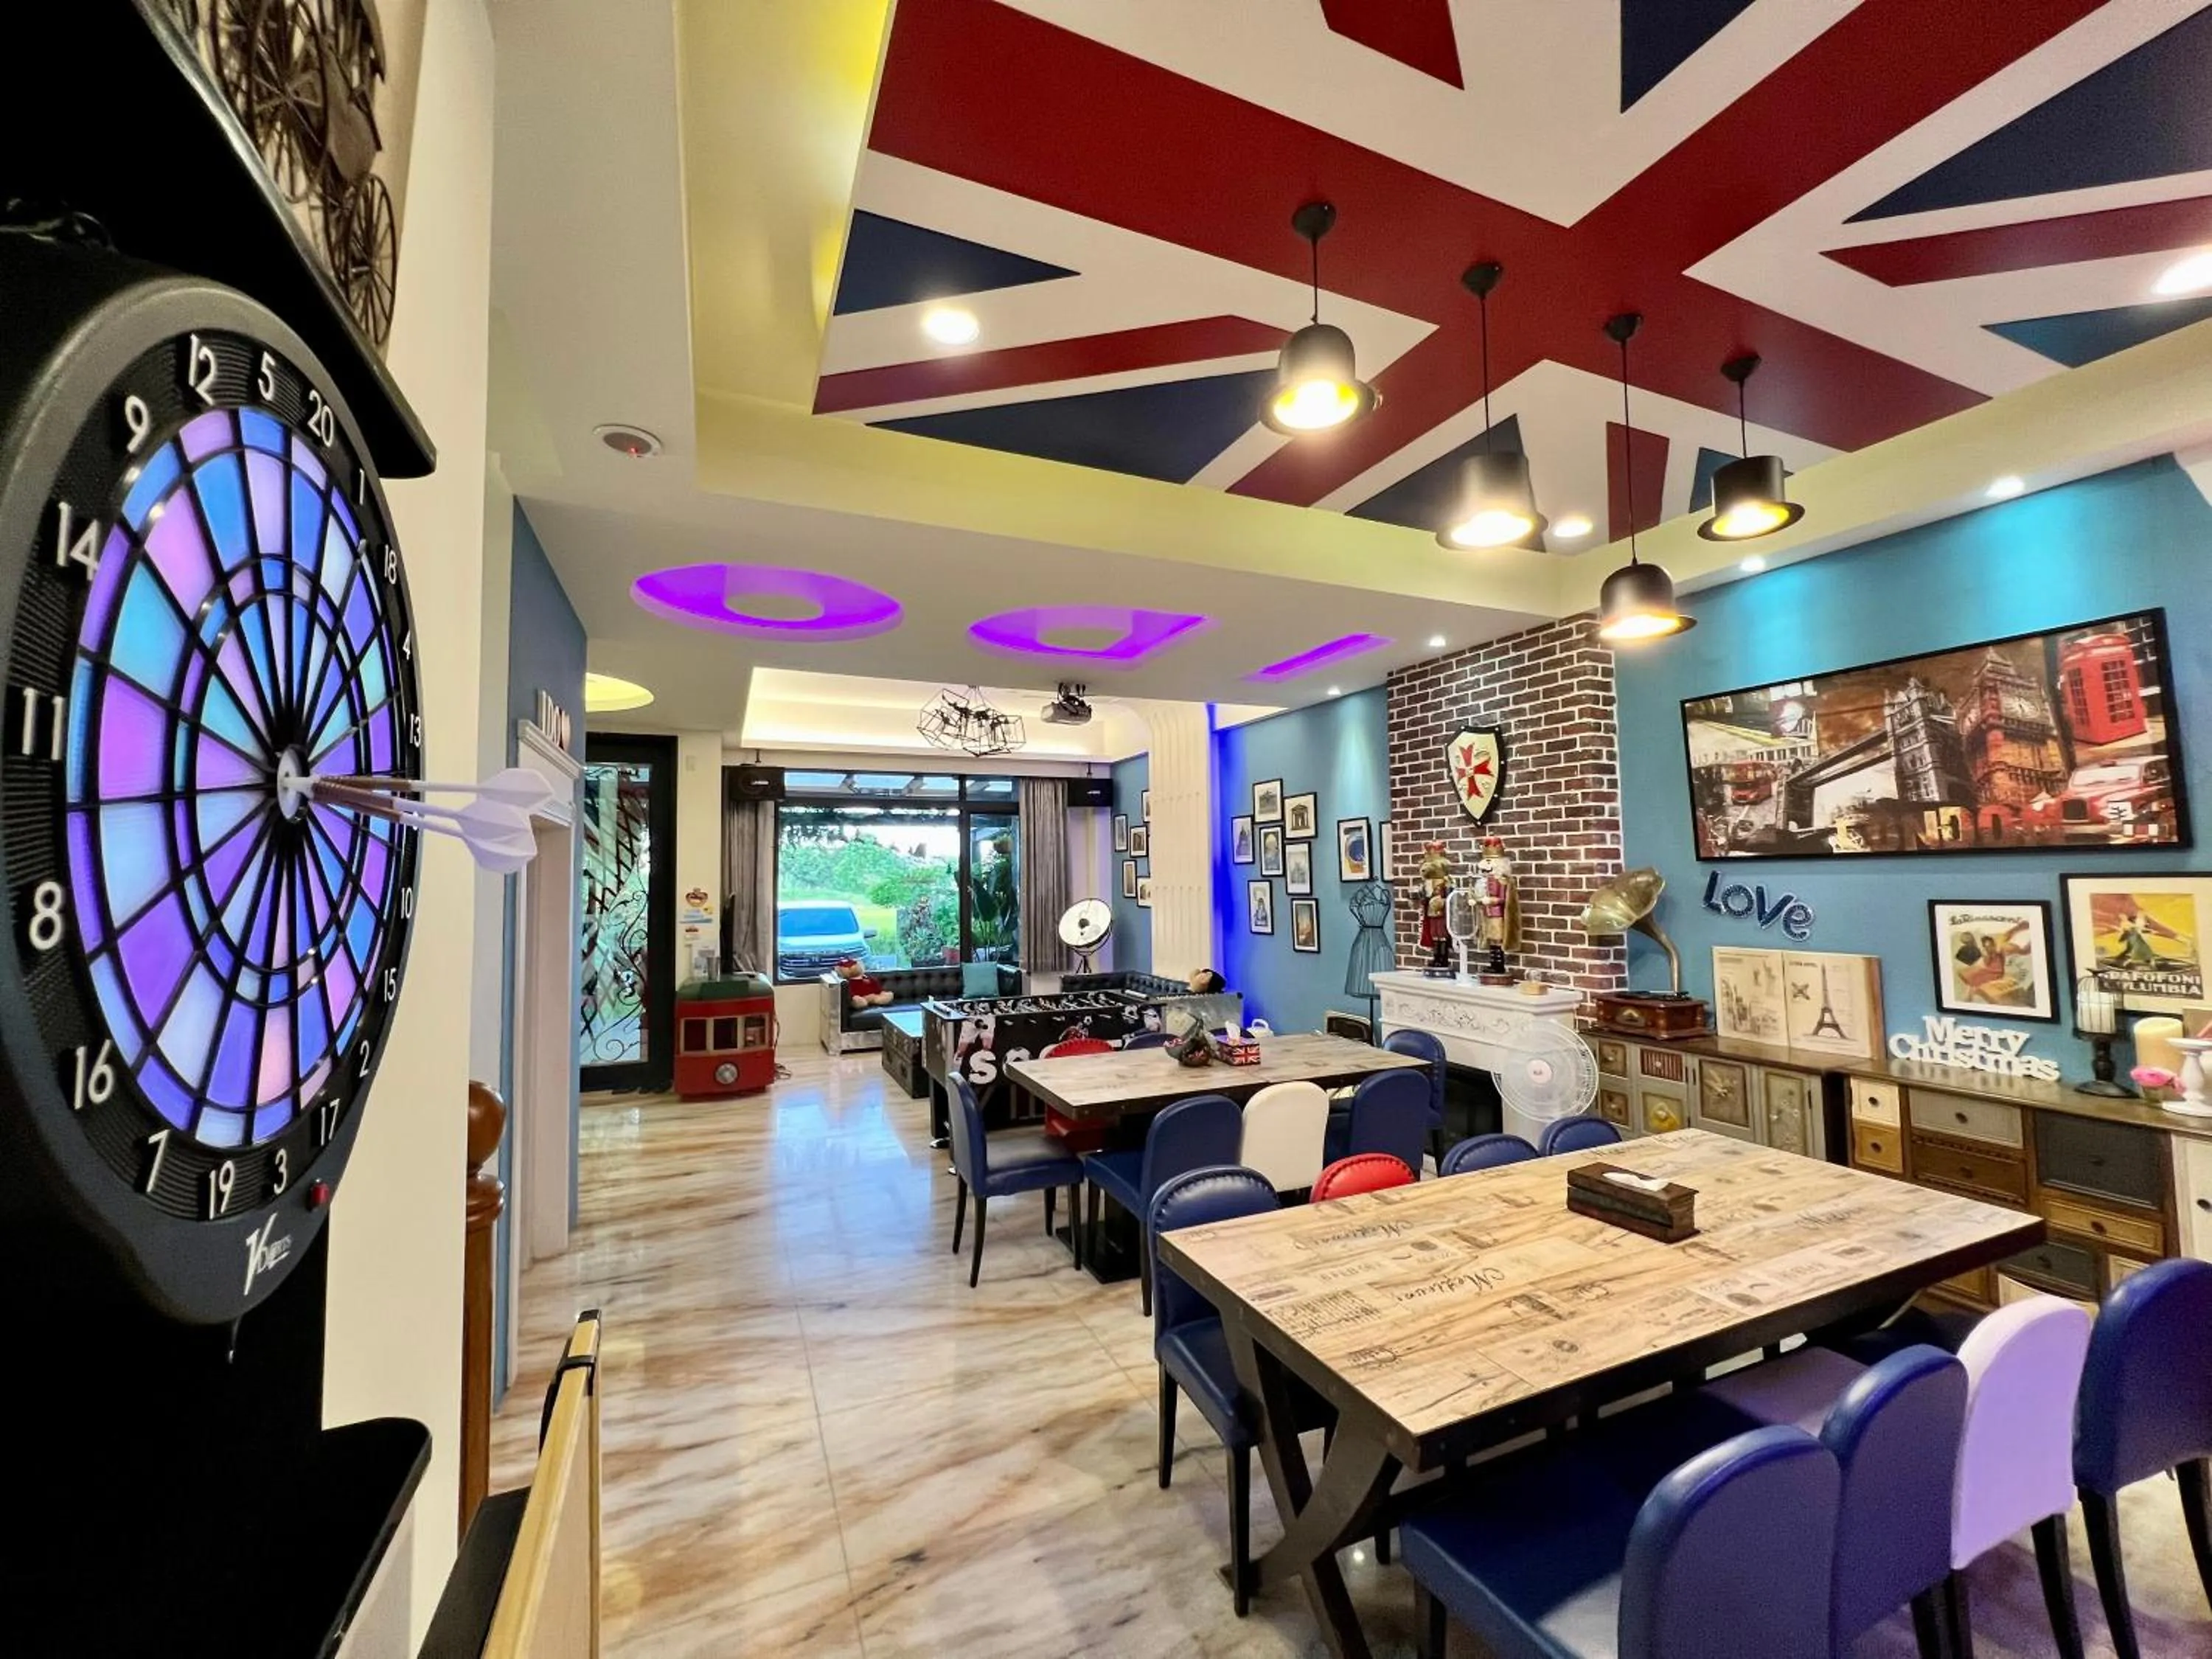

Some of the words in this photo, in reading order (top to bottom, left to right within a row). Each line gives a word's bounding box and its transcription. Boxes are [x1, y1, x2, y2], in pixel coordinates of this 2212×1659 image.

[189, 334, 218, 405] 12
[257, 352, 276, 400] 5
[125, 394, 150, 453] 9
[307, 389, 335, 447] 20
[359, 467, 365, 506] 1
[58, 501, 100, 581] 14
[384, 544, 397, 585] 18
[402, 630, 411, 661] 4
[23, 687, 64, 761] 11
[409, 712, 421, 748] 13
[29, 881, 64, 950] 8
[400, 887, 413, 919] 10
[383, 967, 397, 1003] 15
[358, 1040, 369, 1077] 2
[1889, 1033, 2061, 1082] Christmas
[1922, 1015, 2030, 1057] Merry
[74, 1038, 114, 1110] 16
[321, 1097, 341, 1146] 17
[146, 1129, 170, 1193] 7
[273, 1148, 288, 1194] 3
[209, 1160, 237, 1220] 19
